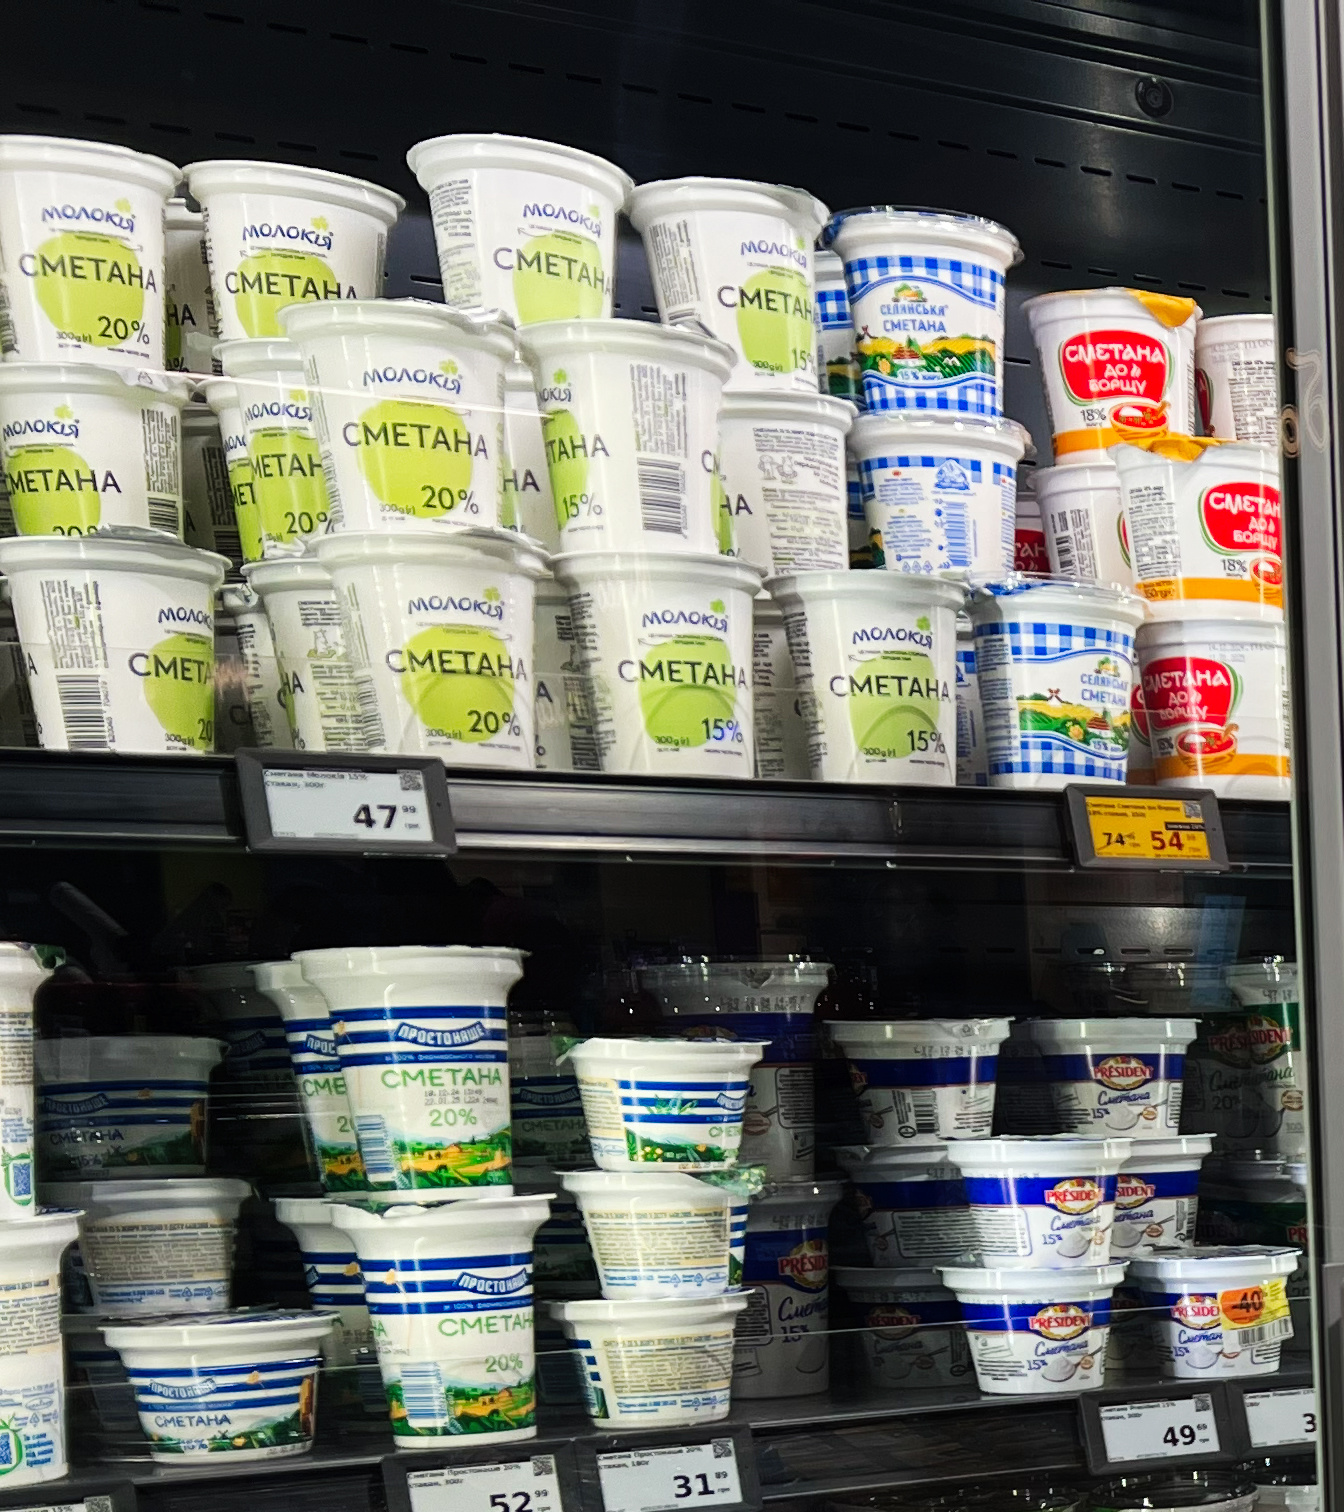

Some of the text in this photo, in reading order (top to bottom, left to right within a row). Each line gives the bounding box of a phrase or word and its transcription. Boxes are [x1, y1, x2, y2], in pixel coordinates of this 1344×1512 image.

[19, 253, 157, 293] СМЕТАНА
[225, 270, 358, 300] СМЕТАНА
[97, 315, 150, 345] 20%
[883, 317, 947, 333] СМЕТАНА
[1064, 343, 1165, 365] СМЕТАНА
[1105, 364, 1127, 379] ДО
[1089, 378, 1147, 394] БОРЩУ
[342, 421, 489, 457] СМЕТАНА
[420, 484, 479, 515] 20%
[562, 493, 603, 516] 15%
[387, 648, 527, 681] СМЕТАНА
[618, 659, 747, 689] СМЕТАНА
[829, 673, 951, 704] СМЕТАНА
[1145, 667, 1230, 690] СМЕТАНА
[467, 709, 521, 737] 20%
[701, 716, 743, 745] 15%
[907, 729, 945, 753] 15%
[352, 803, 417, 829] 47 99
[1150, 831, 1184, 853] 54
[380, 1067, 503, 1090] СМЕТАНА
[1093, 1064, 1154, 1081] PRÉSIDENT
[429, 1108, 478, 1128] 20%
[1029, 1315, 1092, 1333] PRÉSIDENT
[485, 1353, 524, 1372] 20%
[155, 1412, 232, 1428] СМЕТАНА
[1163, 1425, 1196, 1447] 49
[535, 1488, 549, 1498] 99
[673, 1472, 715, 1499] 31
